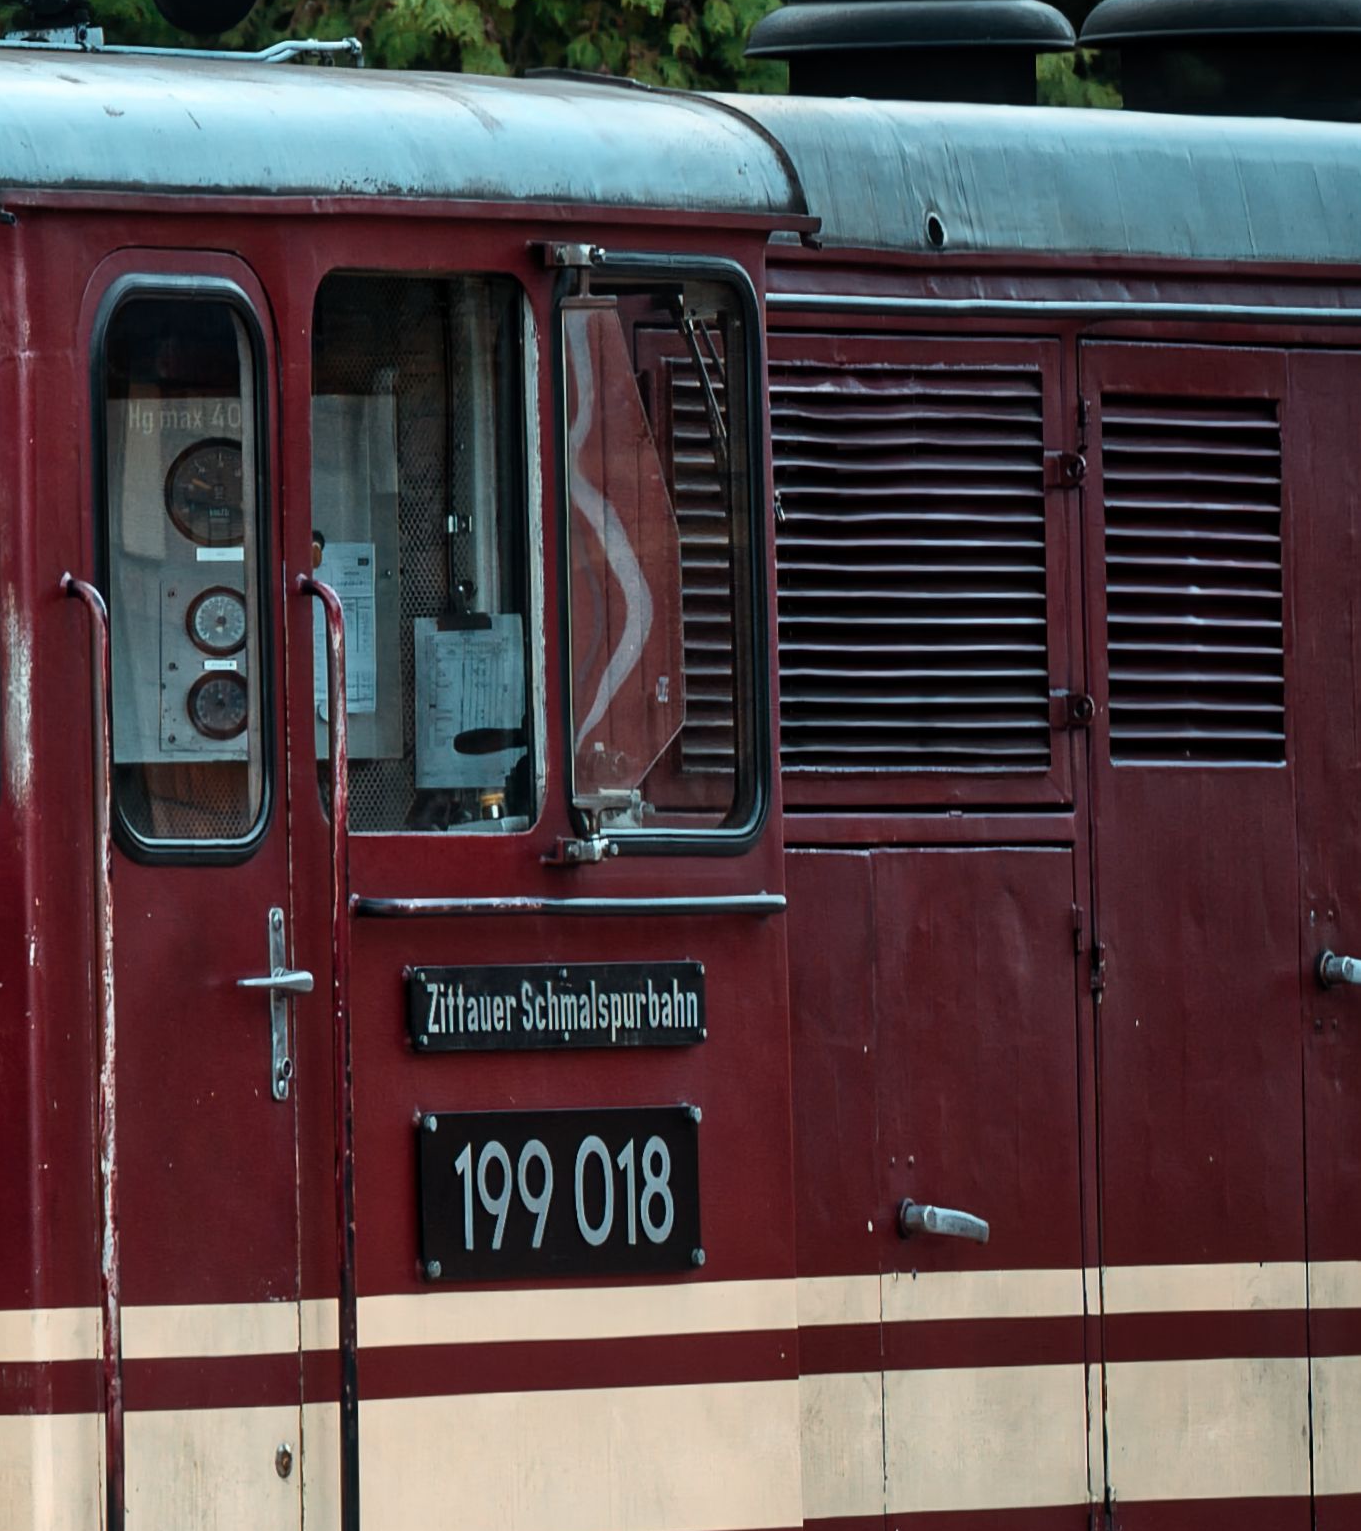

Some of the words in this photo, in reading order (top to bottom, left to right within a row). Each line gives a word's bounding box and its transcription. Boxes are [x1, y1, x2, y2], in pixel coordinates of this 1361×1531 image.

[159, 407, 204, 430] max
[426, 982, 517, 1034] Zittauer
[521, 978, 699, 1043] Schmalspurbahn
[454, 1138, 554, 1251] 199
[574, 1134, 675, 1247] 018
